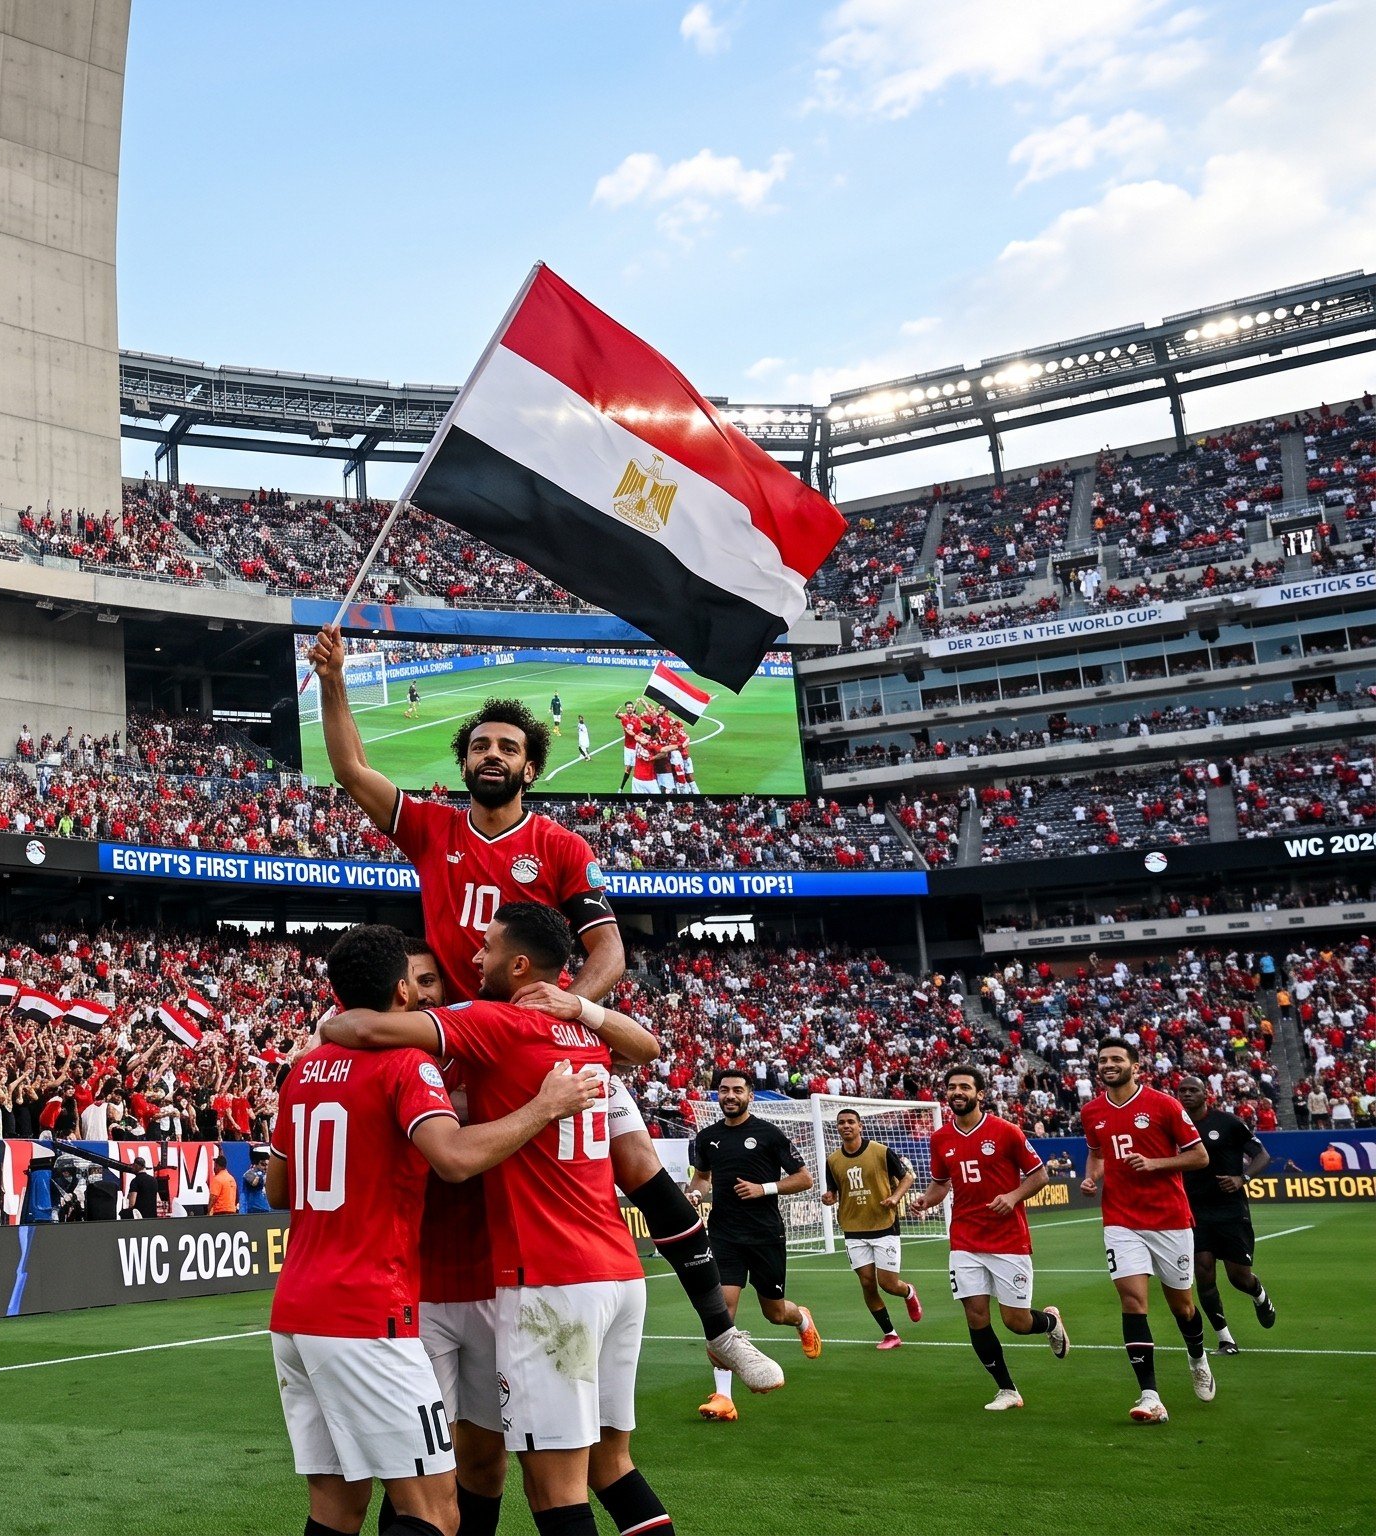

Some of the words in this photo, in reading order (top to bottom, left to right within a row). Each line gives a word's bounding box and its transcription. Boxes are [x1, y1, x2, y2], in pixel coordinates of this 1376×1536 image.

[1037, 624, 1065, 637] THE
[1069, 614, 1123, 632] WORLD
[1284, 837, 1325, 858] WC
[1329, 832, 1376, 854] 202
[112, 848, 191, 875] EGYPT'S
[195, 856, 249, 879] FIRST
[254, 860, 341, 884] HISTORIC
[344, 866, 420, 888] VICTORY
[708, 875, 736, 894] ON
[459, 882, 501, 932] 10
[299, 1059, 352, 1084] SALAH
[291, 1101, 349, 1212] 10
[1111, 1134, 1134, 1160] 12
[959, 1159, 982, 1184] 15
[1243, 1178, 1279, 1199] ST
[117, 1234, 170, 1287] WC
[178, 1230, 259, 1282] 2026:
[266, 1228, 290, 1273] E
[417, 1400, 453, 1456] 10
